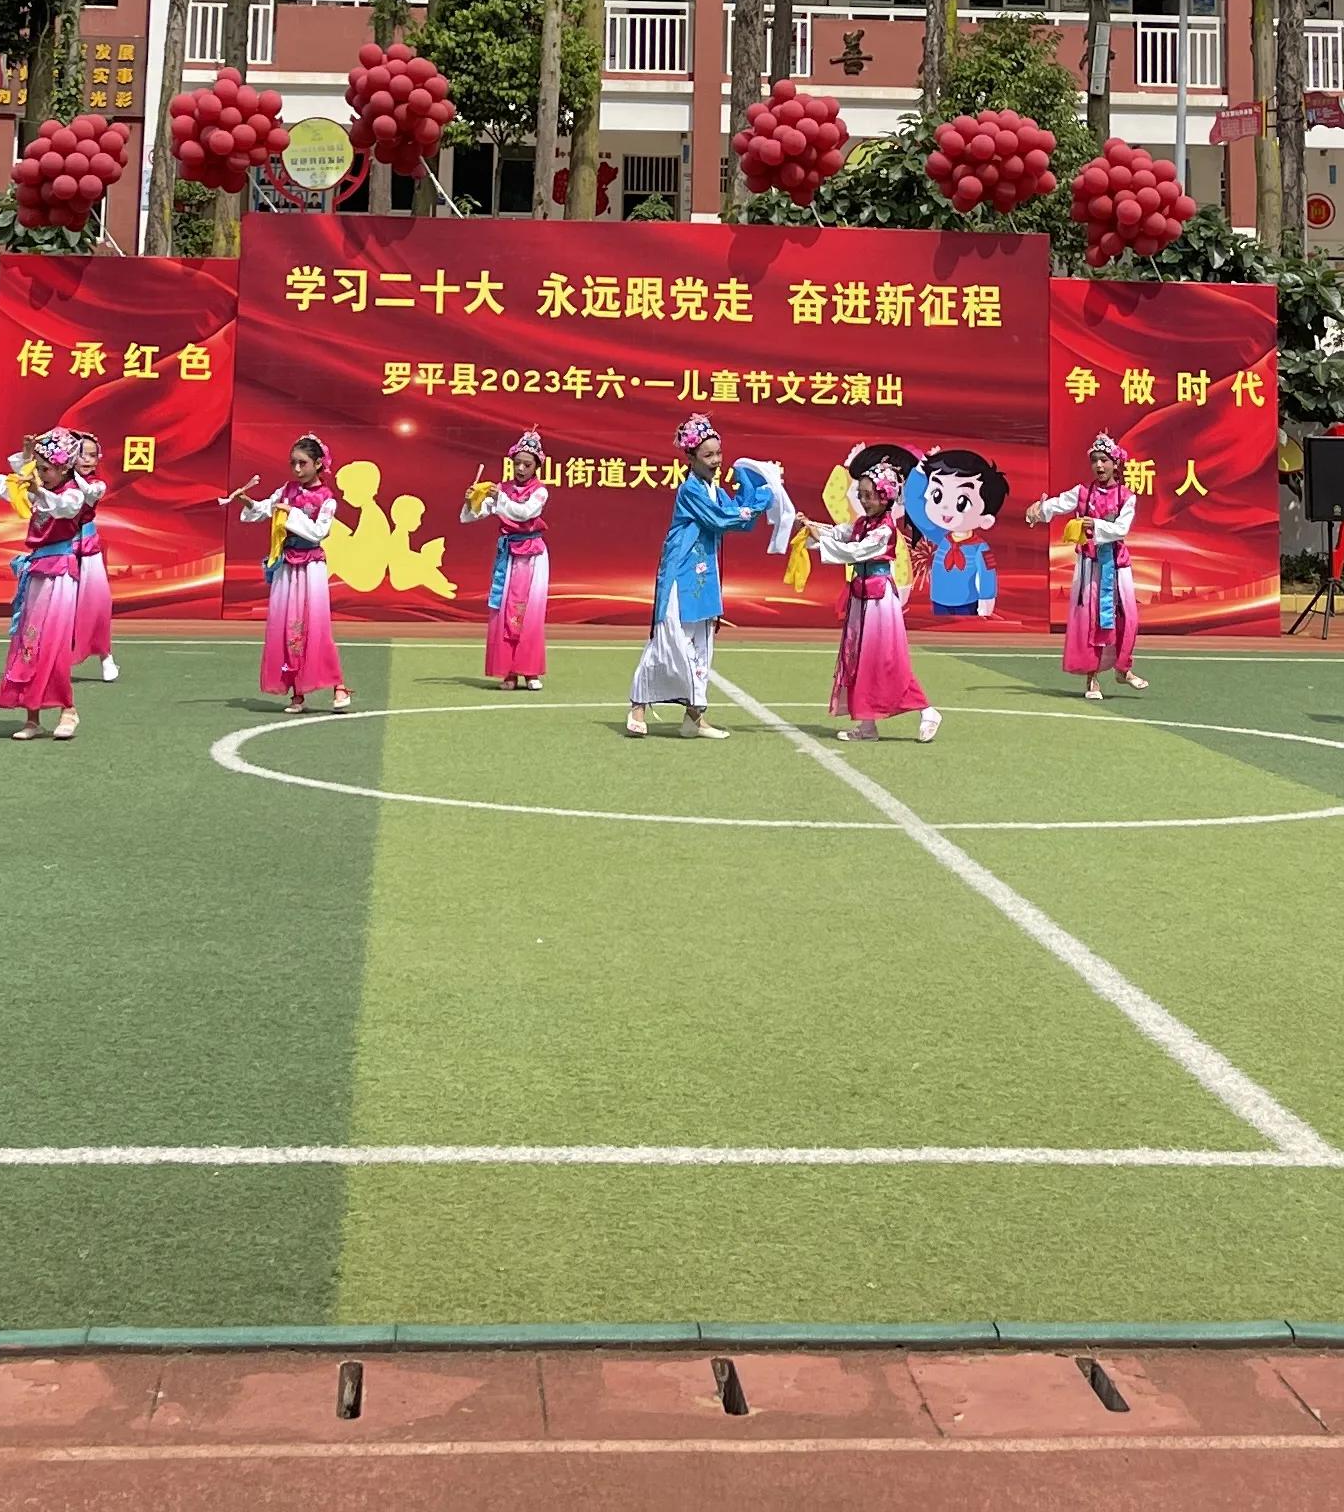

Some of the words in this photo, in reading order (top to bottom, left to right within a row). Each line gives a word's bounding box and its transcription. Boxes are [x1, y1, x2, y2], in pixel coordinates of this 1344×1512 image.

[285, 265, 505, 317] 学习二十大
[536, 272, 755, 324] 永远跟党走
[787, 278, 1004, 329] 奋进新征程
[16, 338, 213, 381] 传承红色
[1064, 366, 1266, 408] 争做时代
[1122, 458, 1210, 496] 新人
